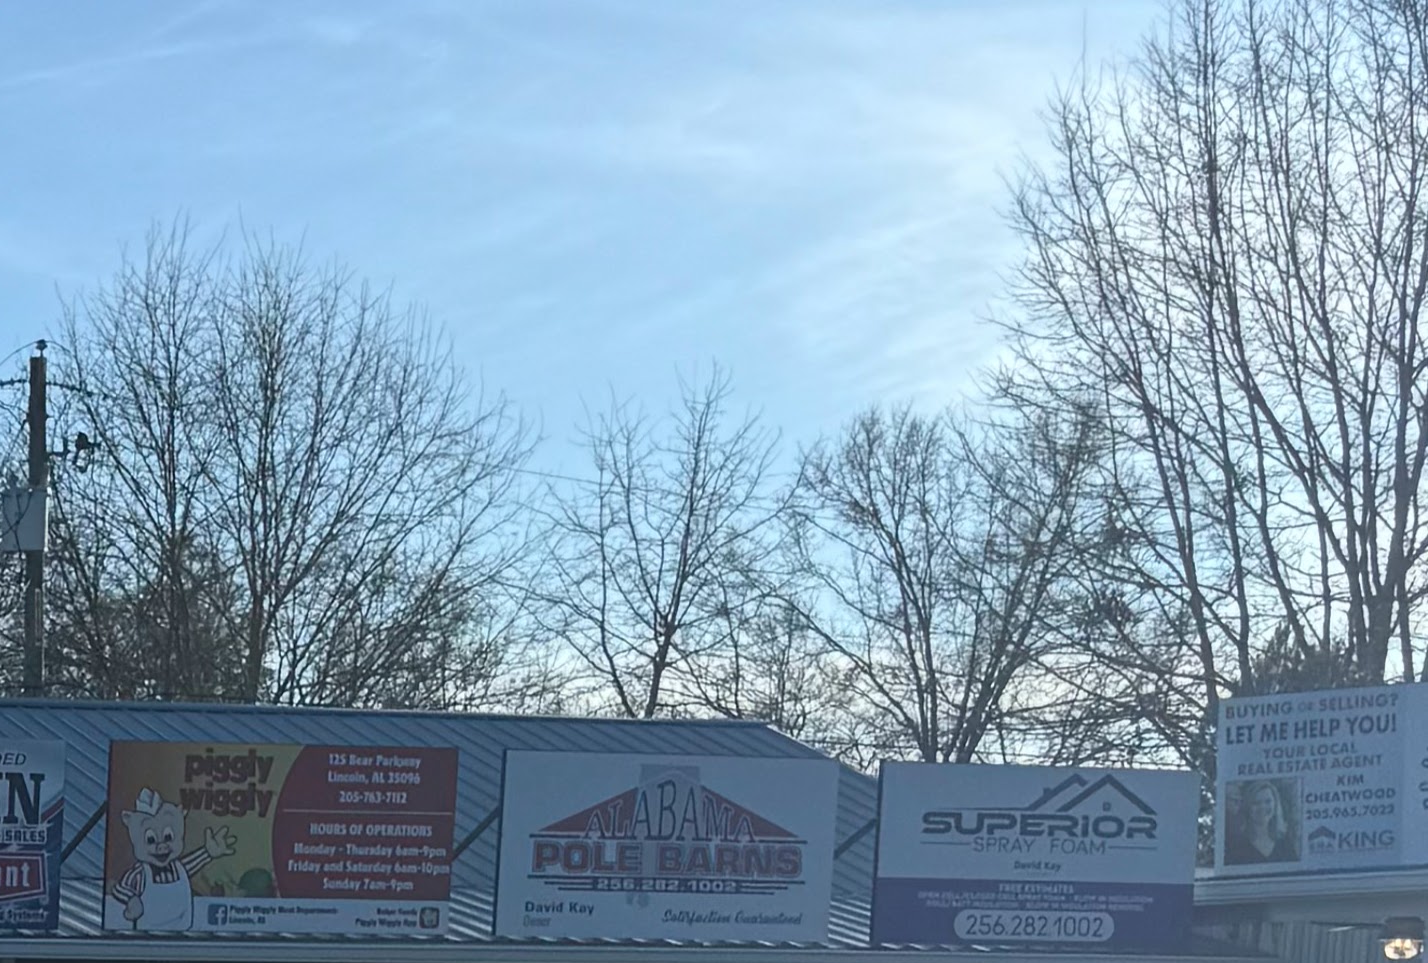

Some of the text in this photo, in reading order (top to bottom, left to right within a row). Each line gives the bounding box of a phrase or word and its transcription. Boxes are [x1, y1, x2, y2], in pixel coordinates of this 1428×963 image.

[1226, 693, 1398, 719] BUYING SELLING?
[1226, 714, 1396, 745] LET ME HELP YOU!
[1263, 742, 1357, 759] YOUR LOCAL
[185, 748, 274, 785] piggly
[375, 755, 422, 769] Parkway
[1238, 754, 1382, 776] REAL ESTATE AGENT
[328, 770, 421, 785] Lincoln, AL 35096
[180, 783, 274, 817] wiggly
[339, 791, 408, 805] 205-763-7112
[1306, 788, 1396, 804] CHEATWOOD
[583, 780, 756, 843] ALABAMA
[310, 823, 432, 838] HOURS OF OPERATIONS
[922, 812, 1158, 839] SUPERIOR
[6, 830, 45, 842] SALES
[1339, 830, 1395, 849] KING
[294, 842, 392, 858] Monday Thursday
[973, 835, 1106, 855] SPRAY FOAM
[288, 860, 391, 875] Friday and Saturday
[531, 839, 803, 879] POLE BARNS
[1014, 860, 1061, 872] David Kay
[323, 878, 361, 892] Sunday
[596, 879, 738, 893] 256.282.1002
[524, 901, 594, 916] David Kay
[662, 909, 803, 926] Satisfaction Guaranteed
[966, 915, 1105, 938] 256.282.1002
